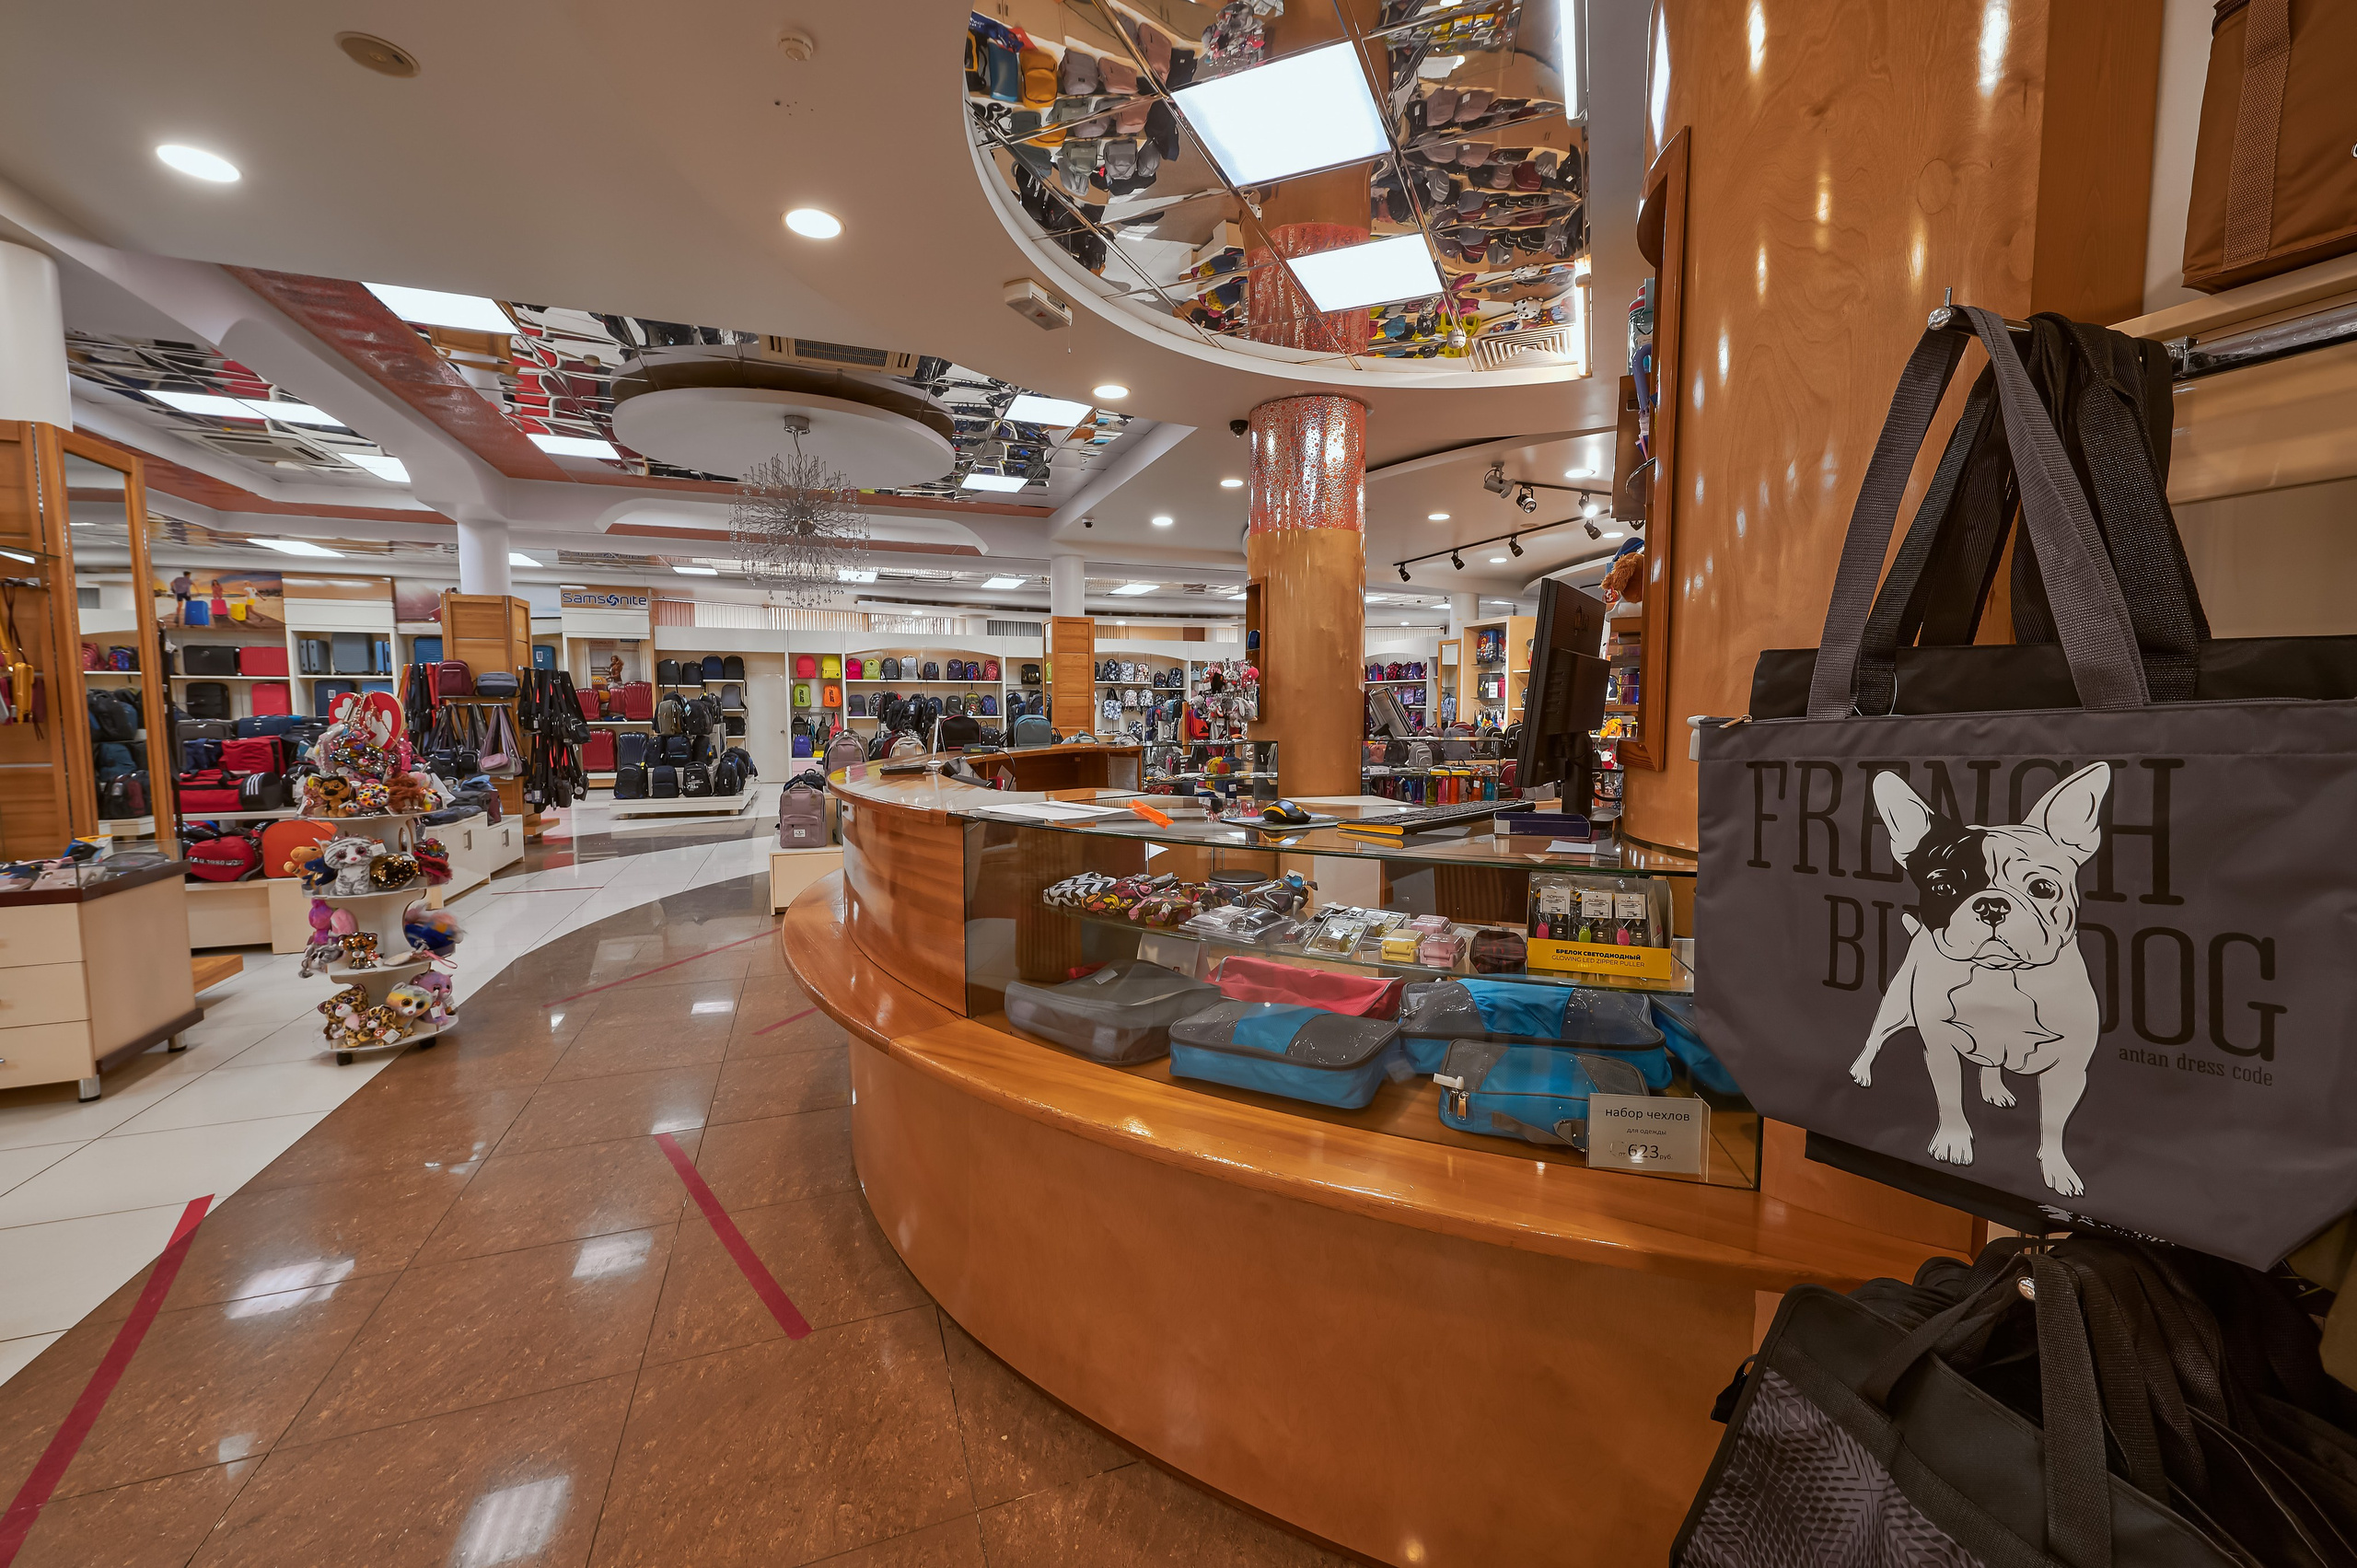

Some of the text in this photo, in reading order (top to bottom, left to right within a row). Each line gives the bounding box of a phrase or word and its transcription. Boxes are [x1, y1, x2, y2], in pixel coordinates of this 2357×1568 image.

[562, 592, 647, 607] Samsonite
[1583, 951, 1642, 960] СВЕТОДИОДНЫЙ
[1822, 894, 2288, 1063] BUDOG
[2119, 1047, 2273, 1086] antan dress code
[1605, 1107, 1690, 1121] набор чехлов
[1628, 1144, 1659, 1159] 623
